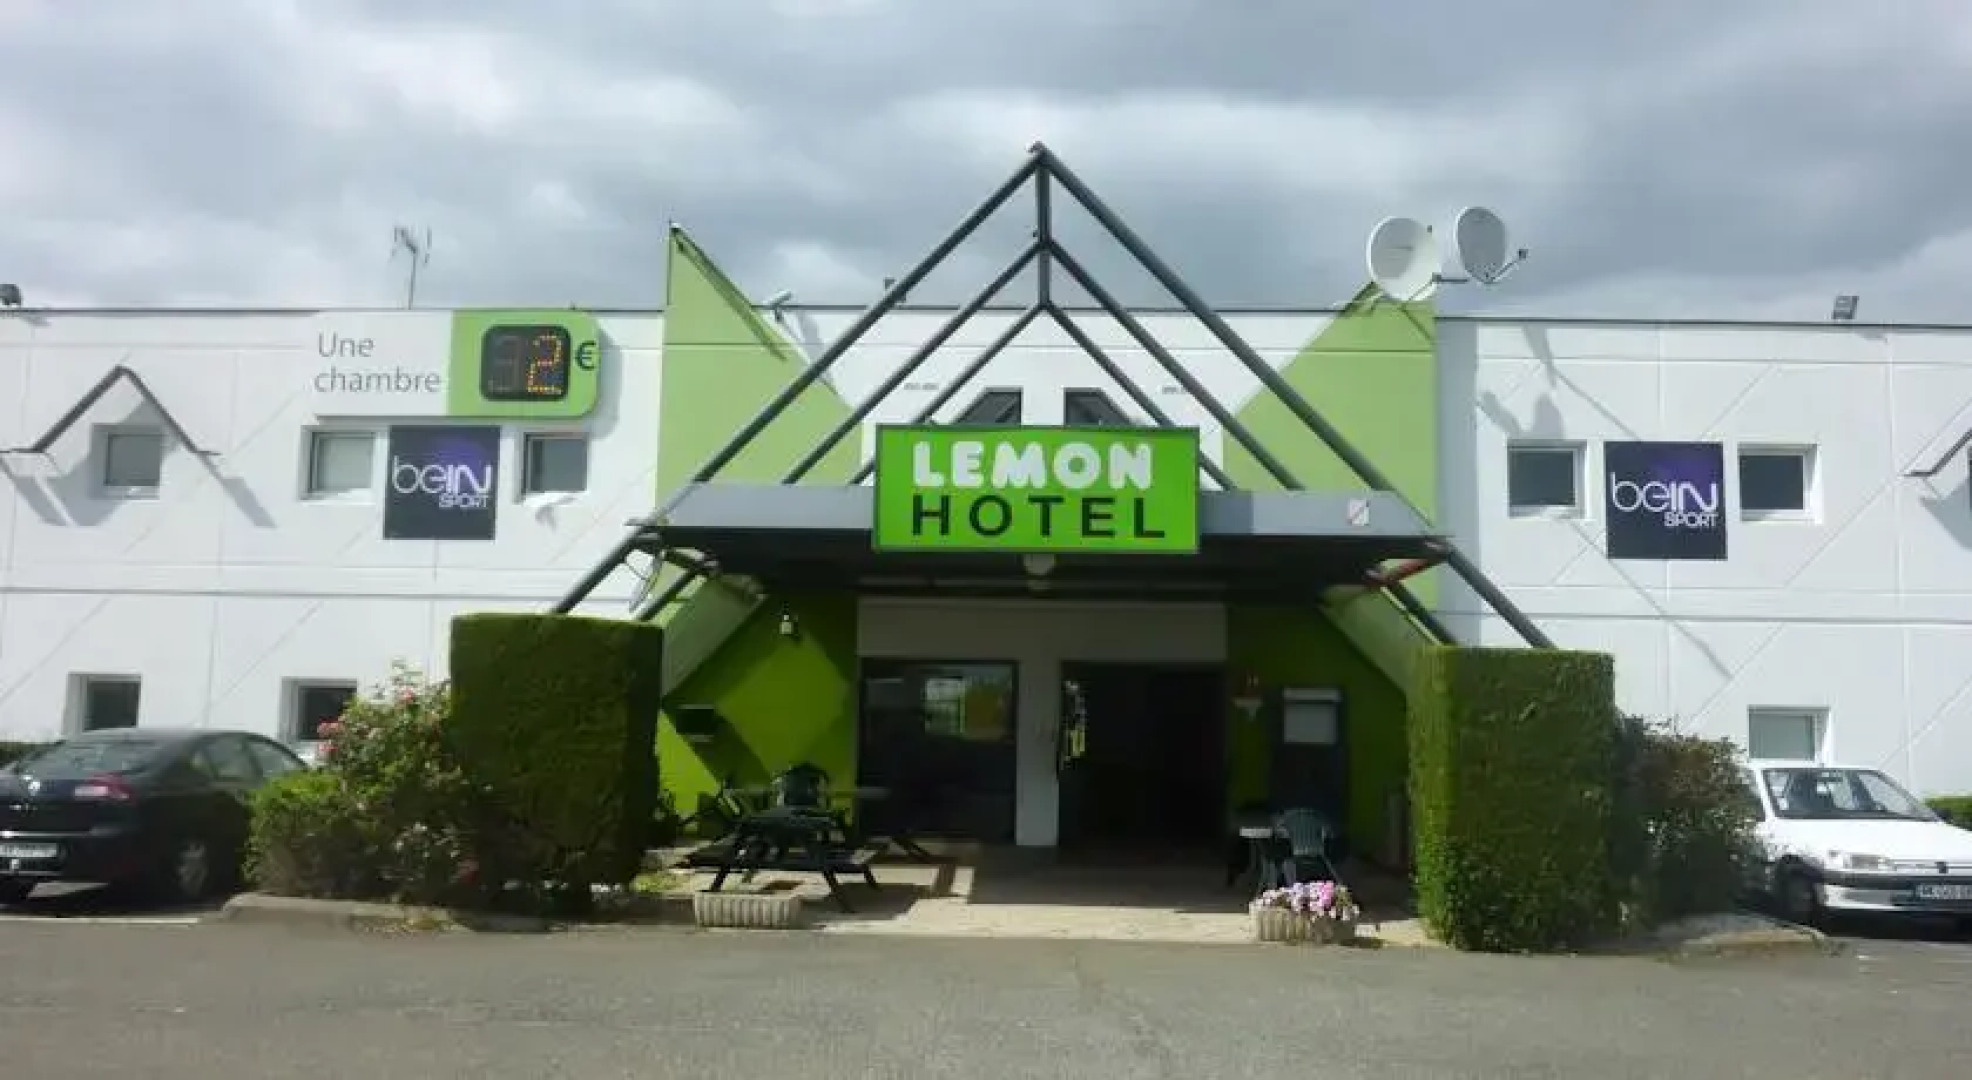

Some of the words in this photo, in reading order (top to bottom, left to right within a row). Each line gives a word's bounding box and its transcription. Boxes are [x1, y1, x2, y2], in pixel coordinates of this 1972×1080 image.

[317, 333, 374, 358] Une
[574, 341, 600, 371] €
[313, 366, 441, 394] chambre
[912, 440, 1154, 490] LEMON
[438, 493, 489, 509] SPORT
[911, 493, 1166, 539] HOTEL
[1663, 511, 1720, 529] SPORT
